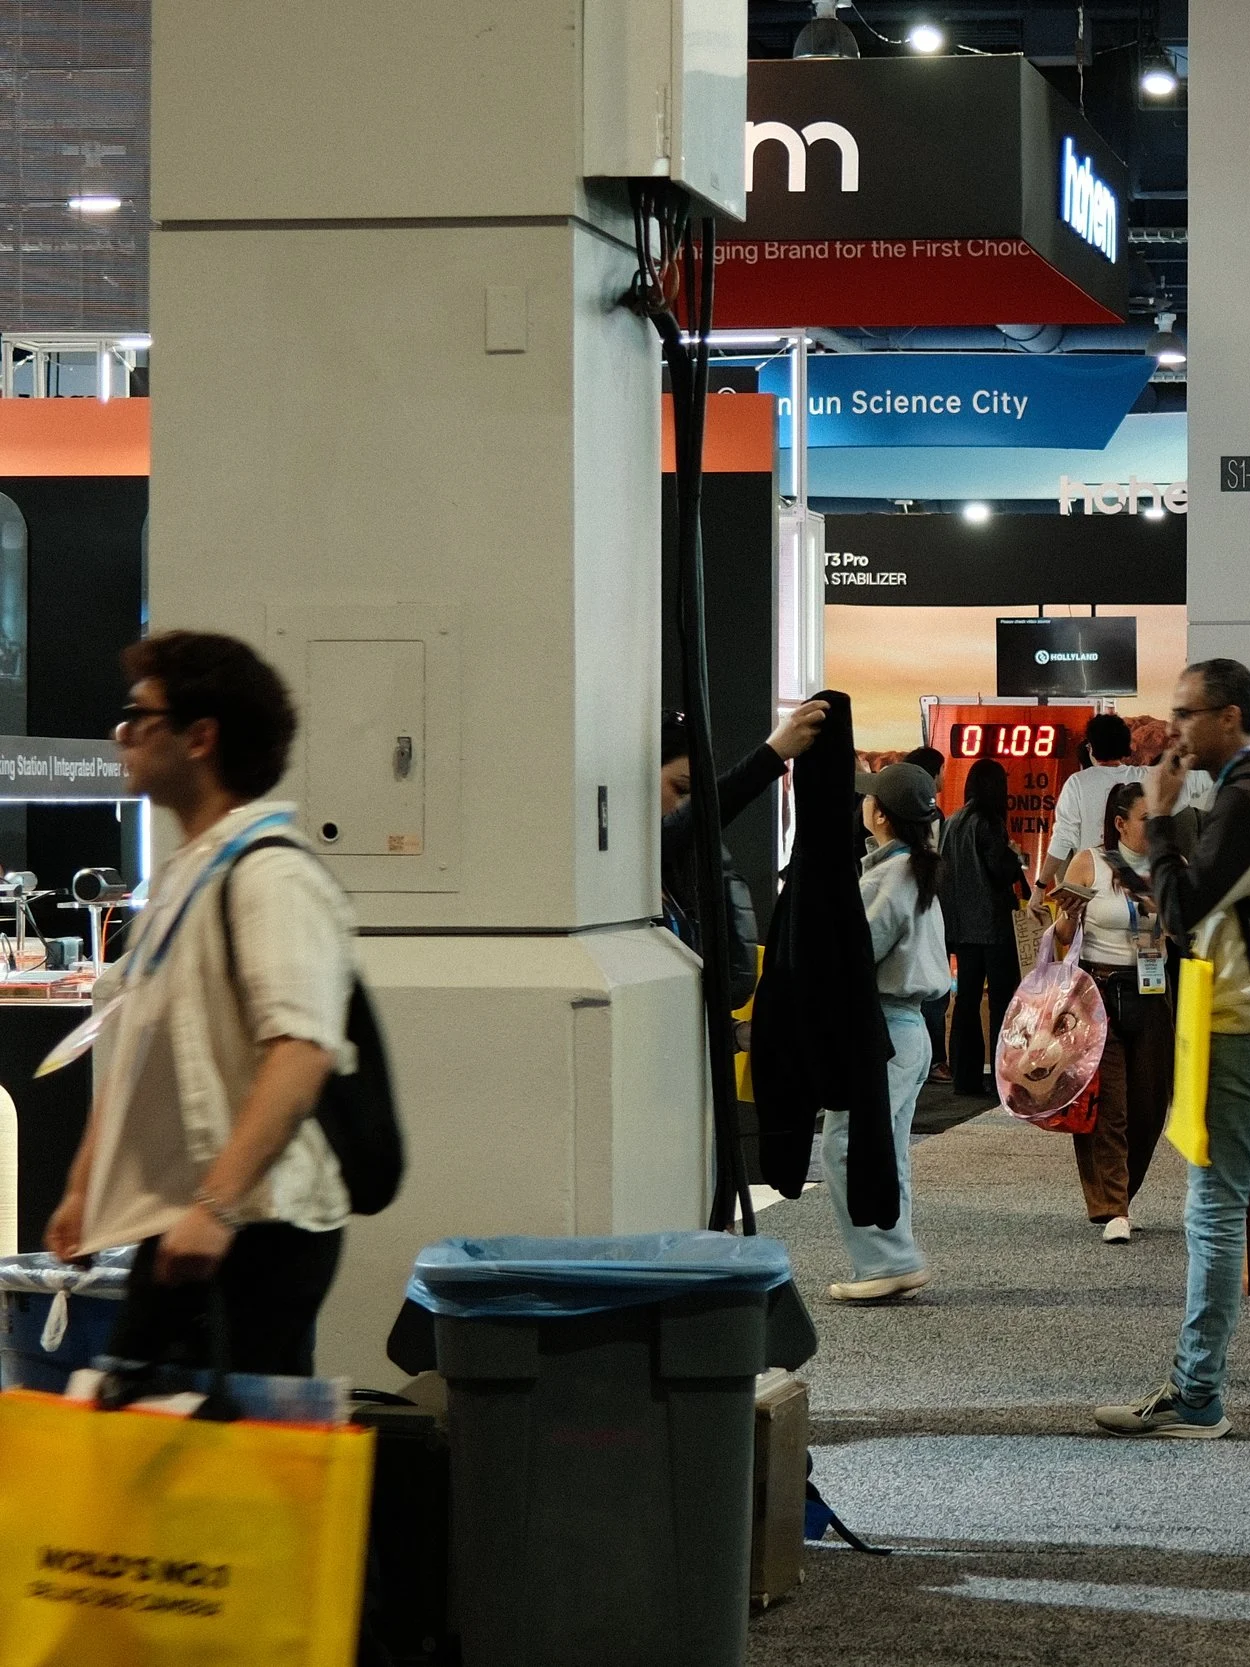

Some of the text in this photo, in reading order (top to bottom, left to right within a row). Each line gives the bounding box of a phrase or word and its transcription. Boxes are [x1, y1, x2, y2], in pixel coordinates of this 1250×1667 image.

[764, 241, 829, 259] Brand
[835, 241, 866, 259] for
[872, 241, 906, 259] the
[913, 240, 961, 258] First
[852, 390, 962, 414] Science
[972, 389, 1028, 420] City
[843, 552, 869, 567] Pro
[831, 572, 907, 585] STABILIZER
[1051, 653, 1098, 661] HOLLYLAND
[17, 755, 48, 776] Station
[54, 756, 96, 782] Integrated
[97, 757, 122, 777] Power
[1010, 816, 1049, 833] WIN
